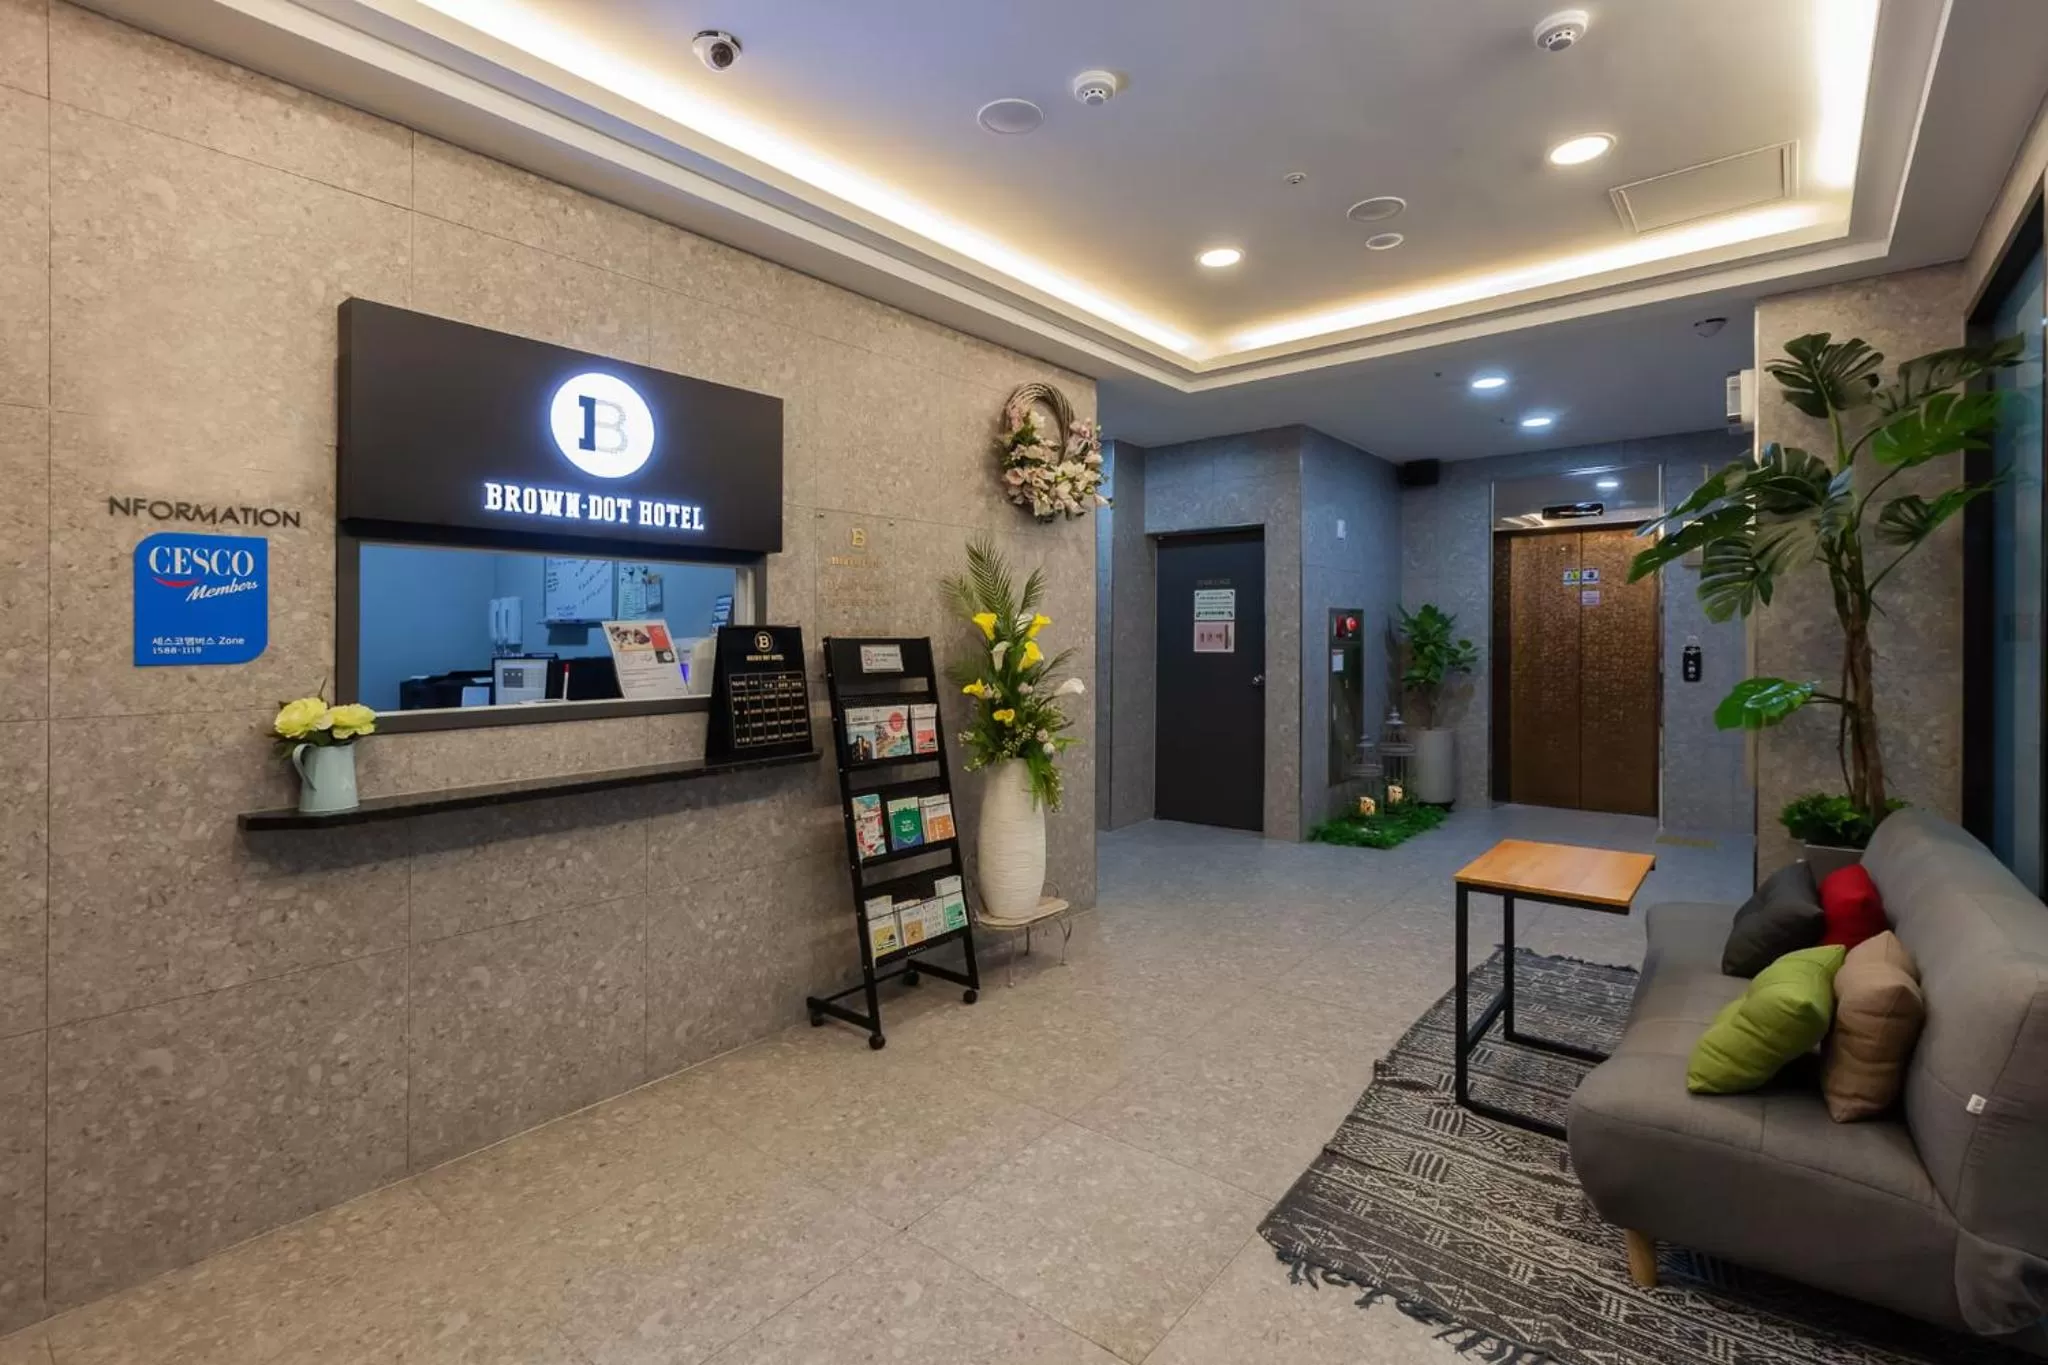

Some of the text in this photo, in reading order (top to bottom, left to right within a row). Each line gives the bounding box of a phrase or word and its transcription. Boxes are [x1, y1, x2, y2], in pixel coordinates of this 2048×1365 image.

[109, 496, 300, 528] NFORMATION
[640, 501, 704, 530] HOTEL
[149, 546, 254, 577] CESCO
[185, 577, 258, 601] Members
[218, 636, 245, 645] Zone
